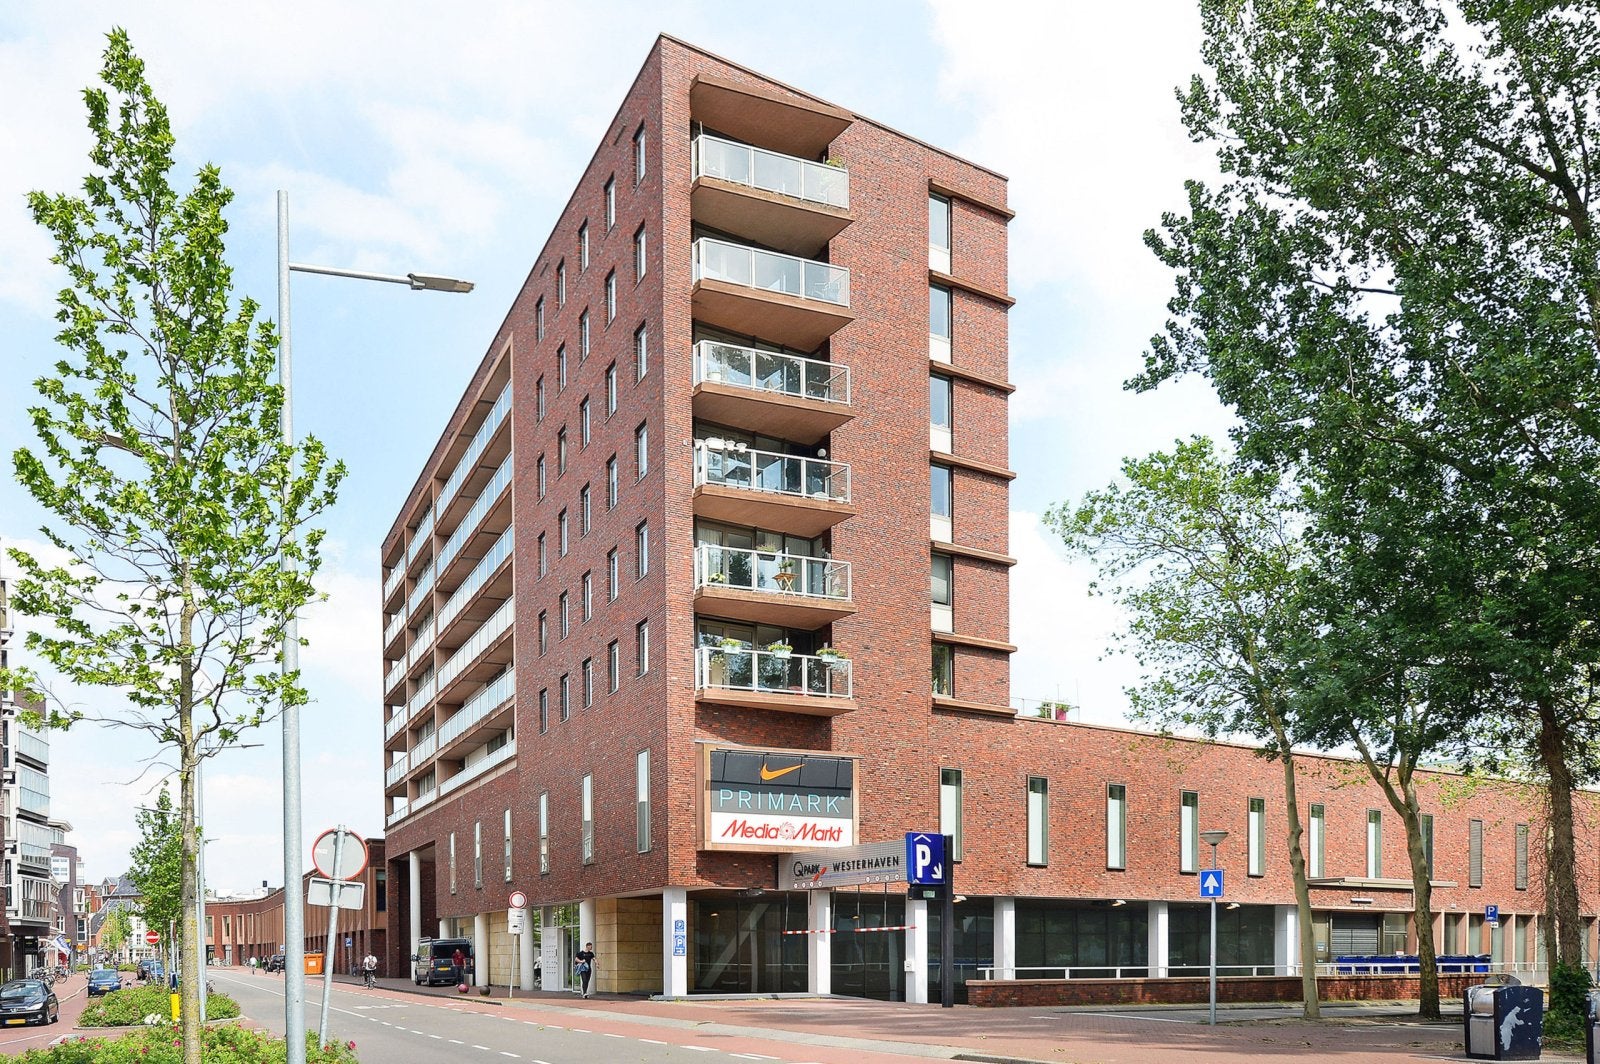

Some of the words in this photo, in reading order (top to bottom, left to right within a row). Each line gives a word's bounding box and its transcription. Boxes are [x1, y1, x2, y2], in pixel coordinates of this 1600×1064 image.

[719, 789, 840, 814] PRIMARK
[832, 855, 899, 873] WESTERHAVEN
[916, 844, 931, 879] P
